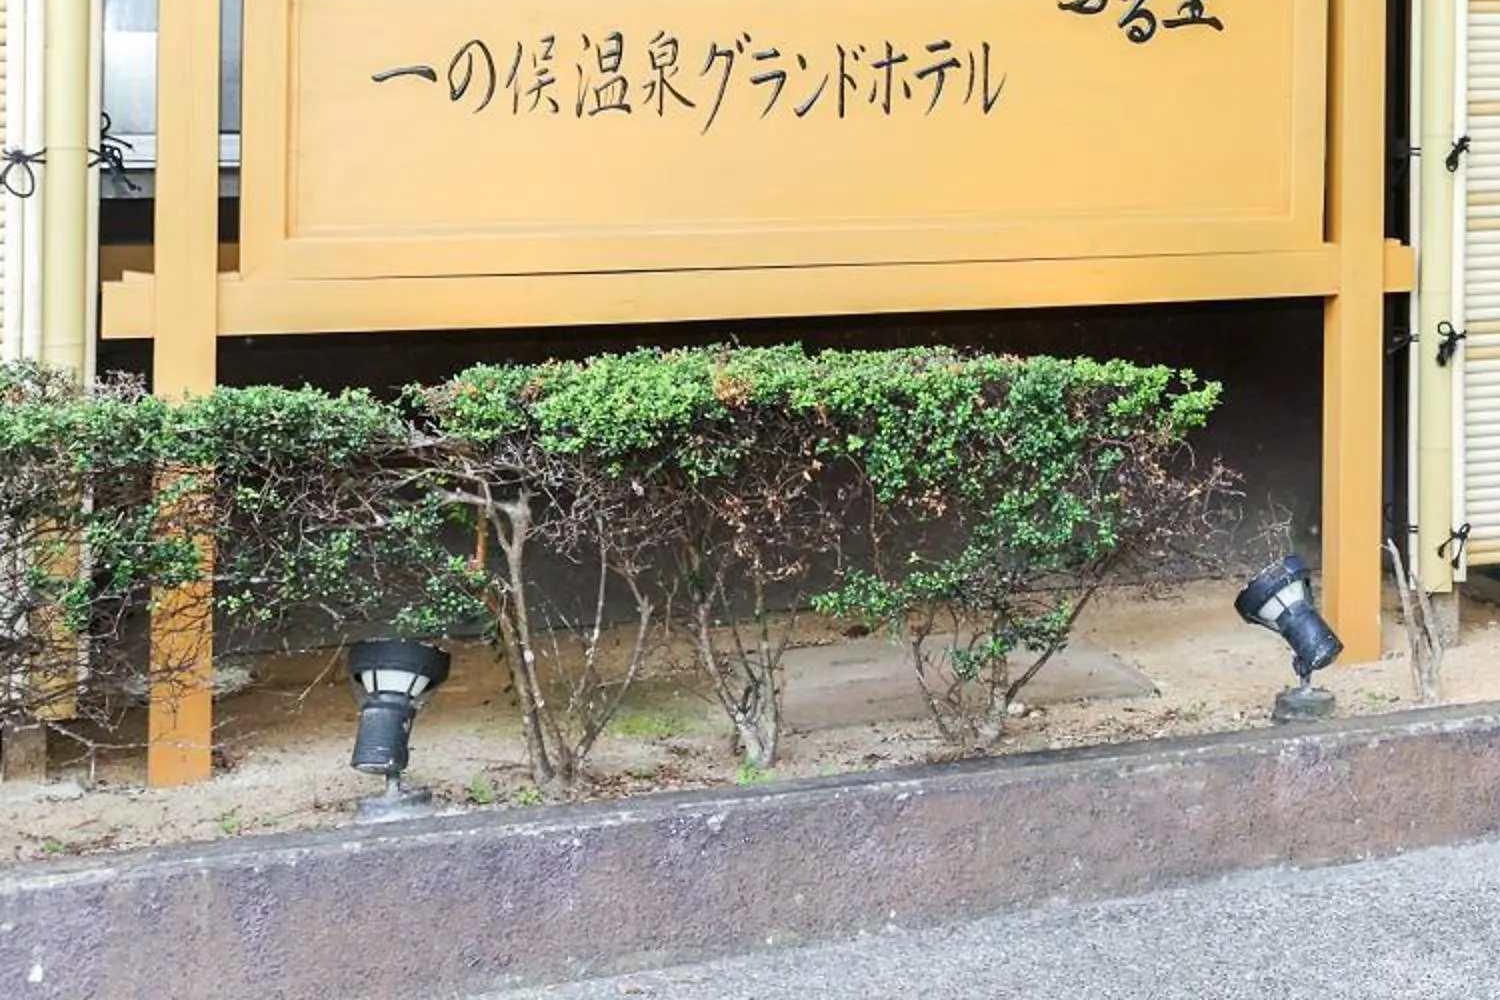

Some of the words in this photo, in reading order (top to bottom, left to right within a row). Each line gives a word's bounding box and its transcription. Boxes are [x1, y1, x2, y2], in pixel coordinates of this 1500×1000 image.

[371, 31, 1007, 135] 一の俣温泉グランドホテル
